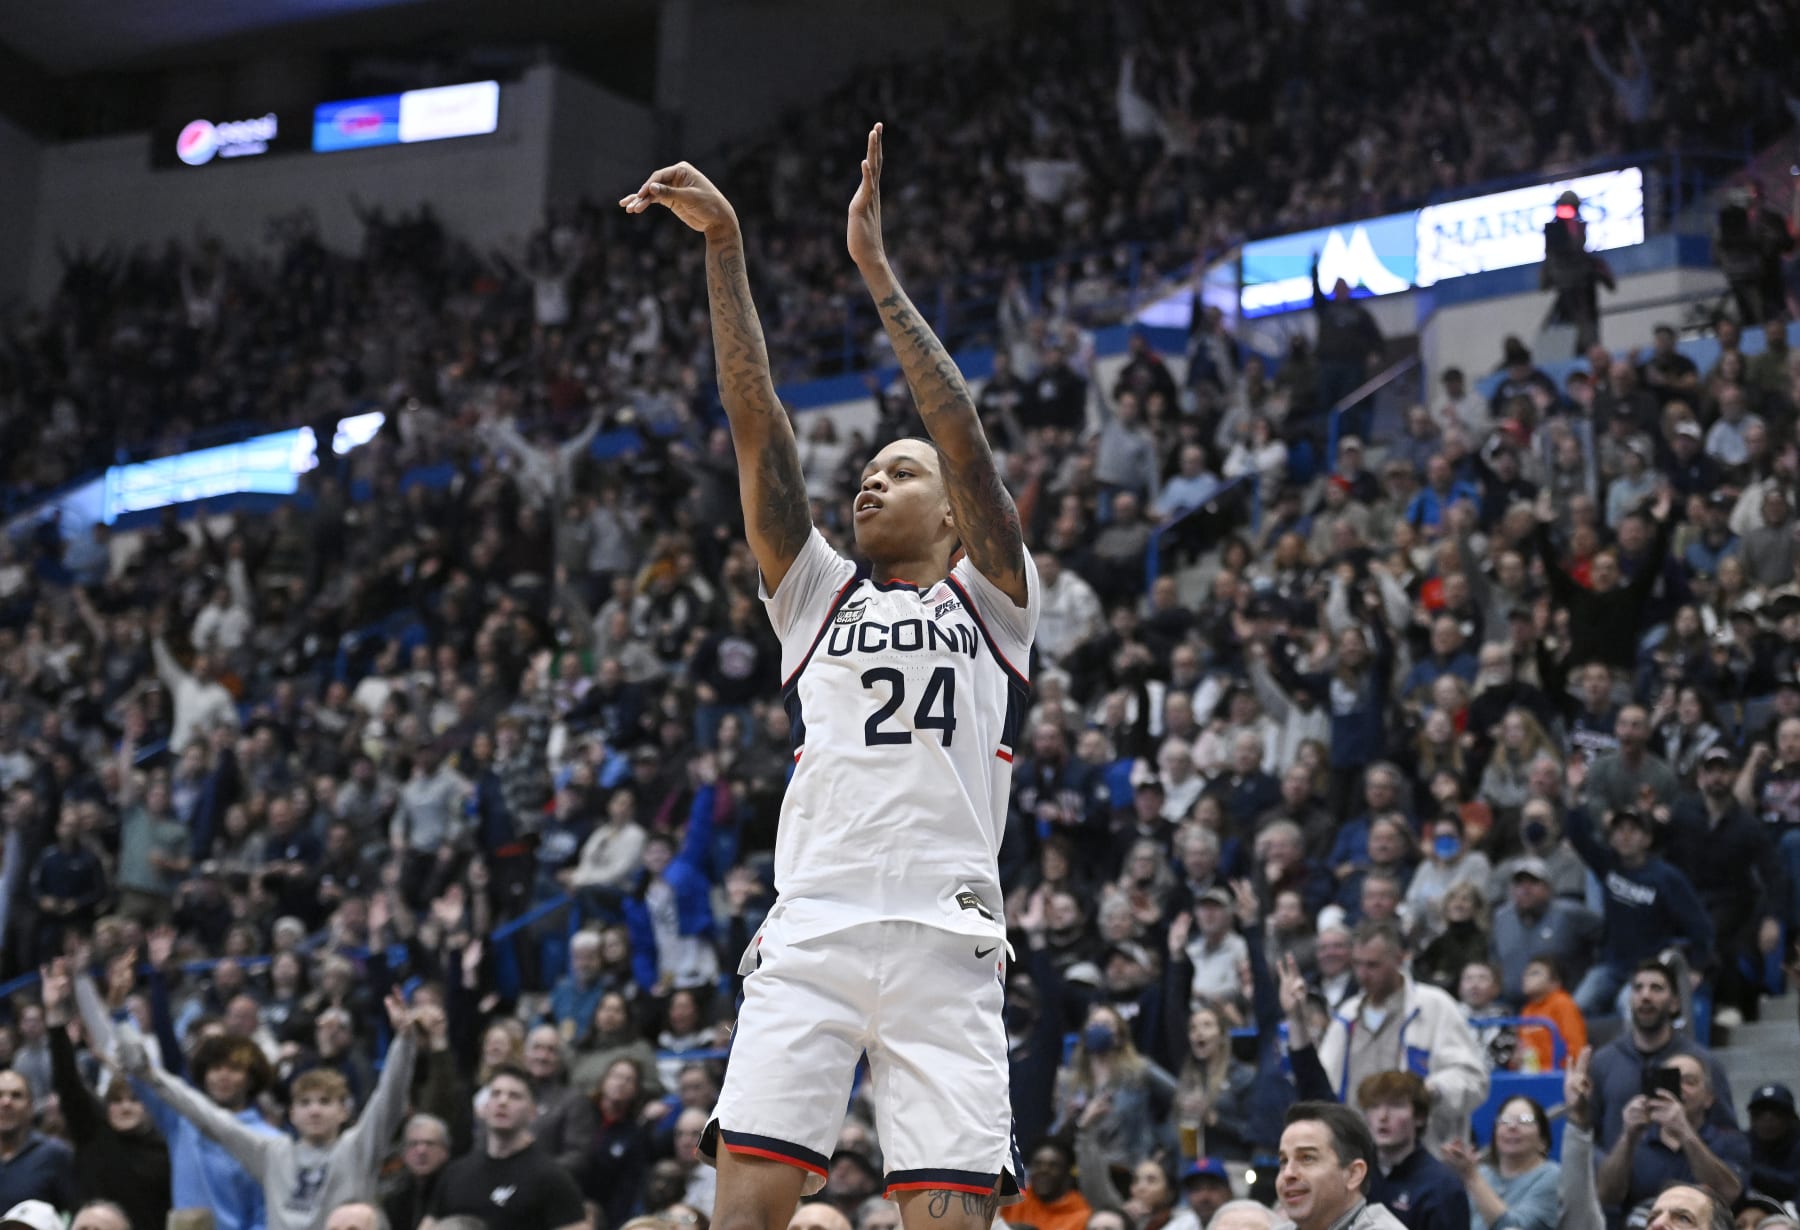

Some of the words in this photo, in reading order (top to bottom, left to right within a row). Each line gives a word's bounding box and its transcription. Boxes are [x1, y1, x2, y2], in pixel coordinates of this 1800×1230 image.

[1433, 192, 1609, 249] MARCS
[935, 599, 954, 613] BIG
[828, 619, 979, 660] UCONN
[861, 667, 957, 747] 24
